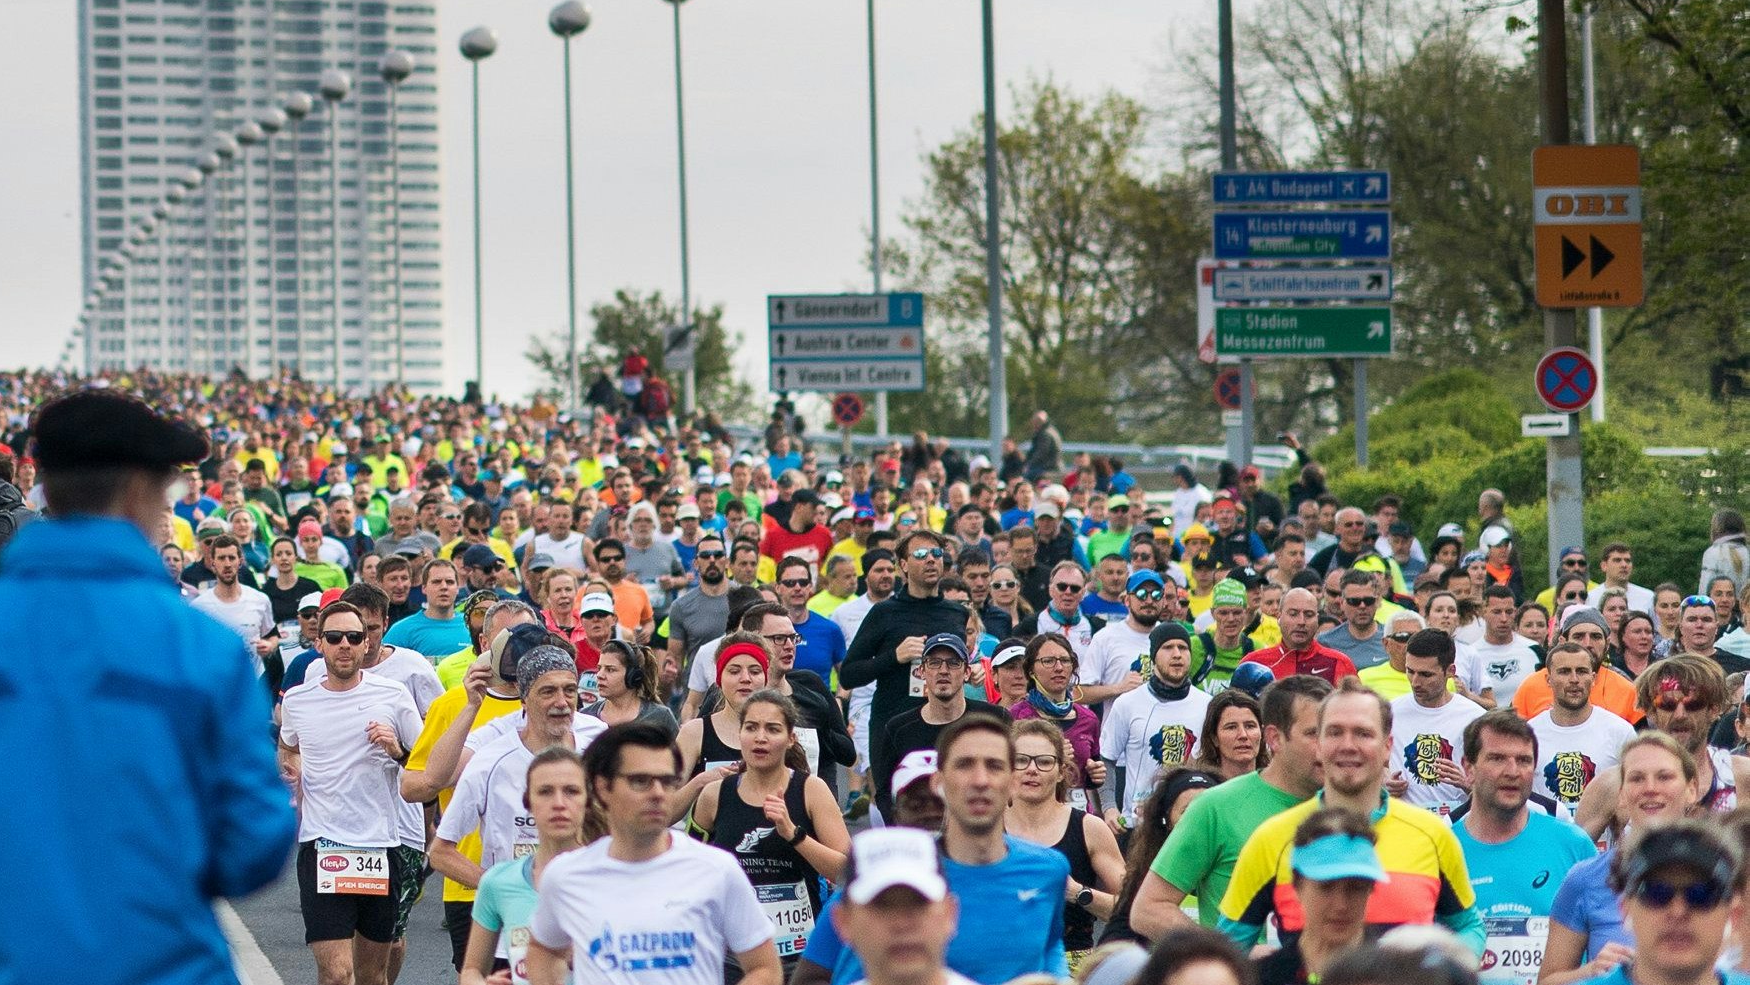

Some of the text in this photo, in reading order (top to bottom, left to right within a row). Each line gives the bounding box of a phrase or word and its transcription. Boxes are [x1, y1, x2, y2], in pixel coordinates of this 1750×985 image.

[1247, 179, 1334, 198] A4 Budapest
[1545, 193, 1630, 217] OBI
[1225, 227, 1240, 246] 14
[1247, 218, 1357, 238] Klosterneuburg
[1245, 313, 1298, 330] Stadion
[795, 334, 890, 350] Austria Center
[1222, 332, 1325, 350] Messezentrum
[797, 368, 842, 383] Vienna
[868, 367, 911, 383] Centre
[321, 856, 383, 873] Hervis 344
[766, 858, 794, 868] TEAM
[775, 904, 812, 926] 11050
[1491, 902, 1532, 915] EDITION
